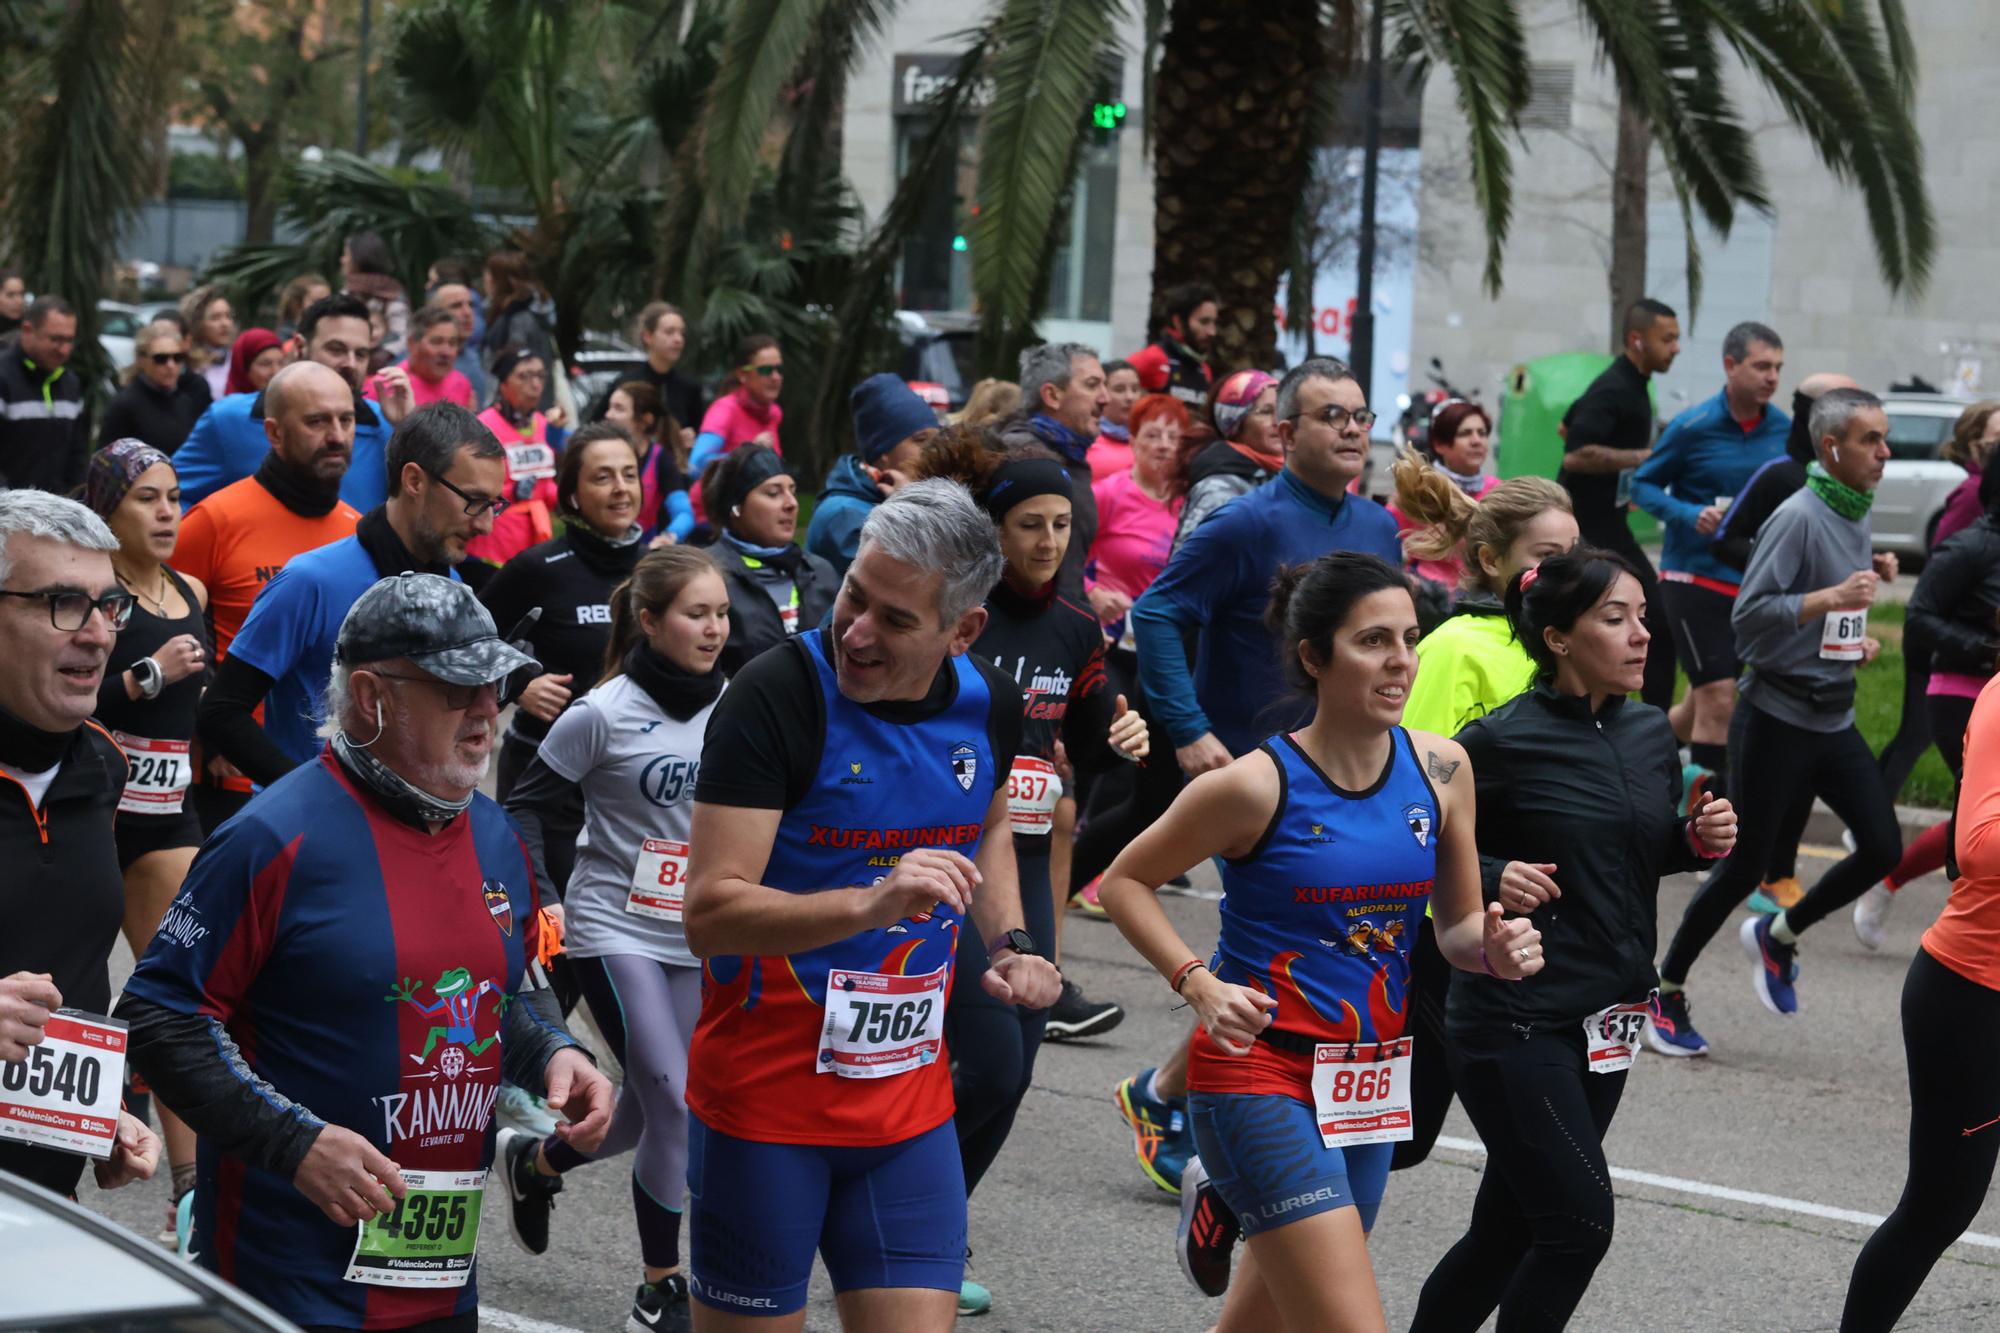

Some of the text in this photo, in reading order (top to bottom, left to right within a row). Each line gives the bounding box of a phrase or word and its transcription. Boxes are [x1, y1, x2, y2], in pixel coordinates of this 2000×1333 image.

[867, 855, 900, 867] ALB
[847, 998, 933, 1044] 7562
[2, 1045, 101, 1107] 6540
[1332, 1066, 1392, 1102] 866
[9, 1106, 76, 1127] #ValènciaCorre
[377, 1194, 468, 1241] 4355
[1260, 1187, 1340, 1218] LURBEL
[387, 1259, 443, 1269] #ValènciaCorre
[707, 1285, 778, 1308] LURBEL
